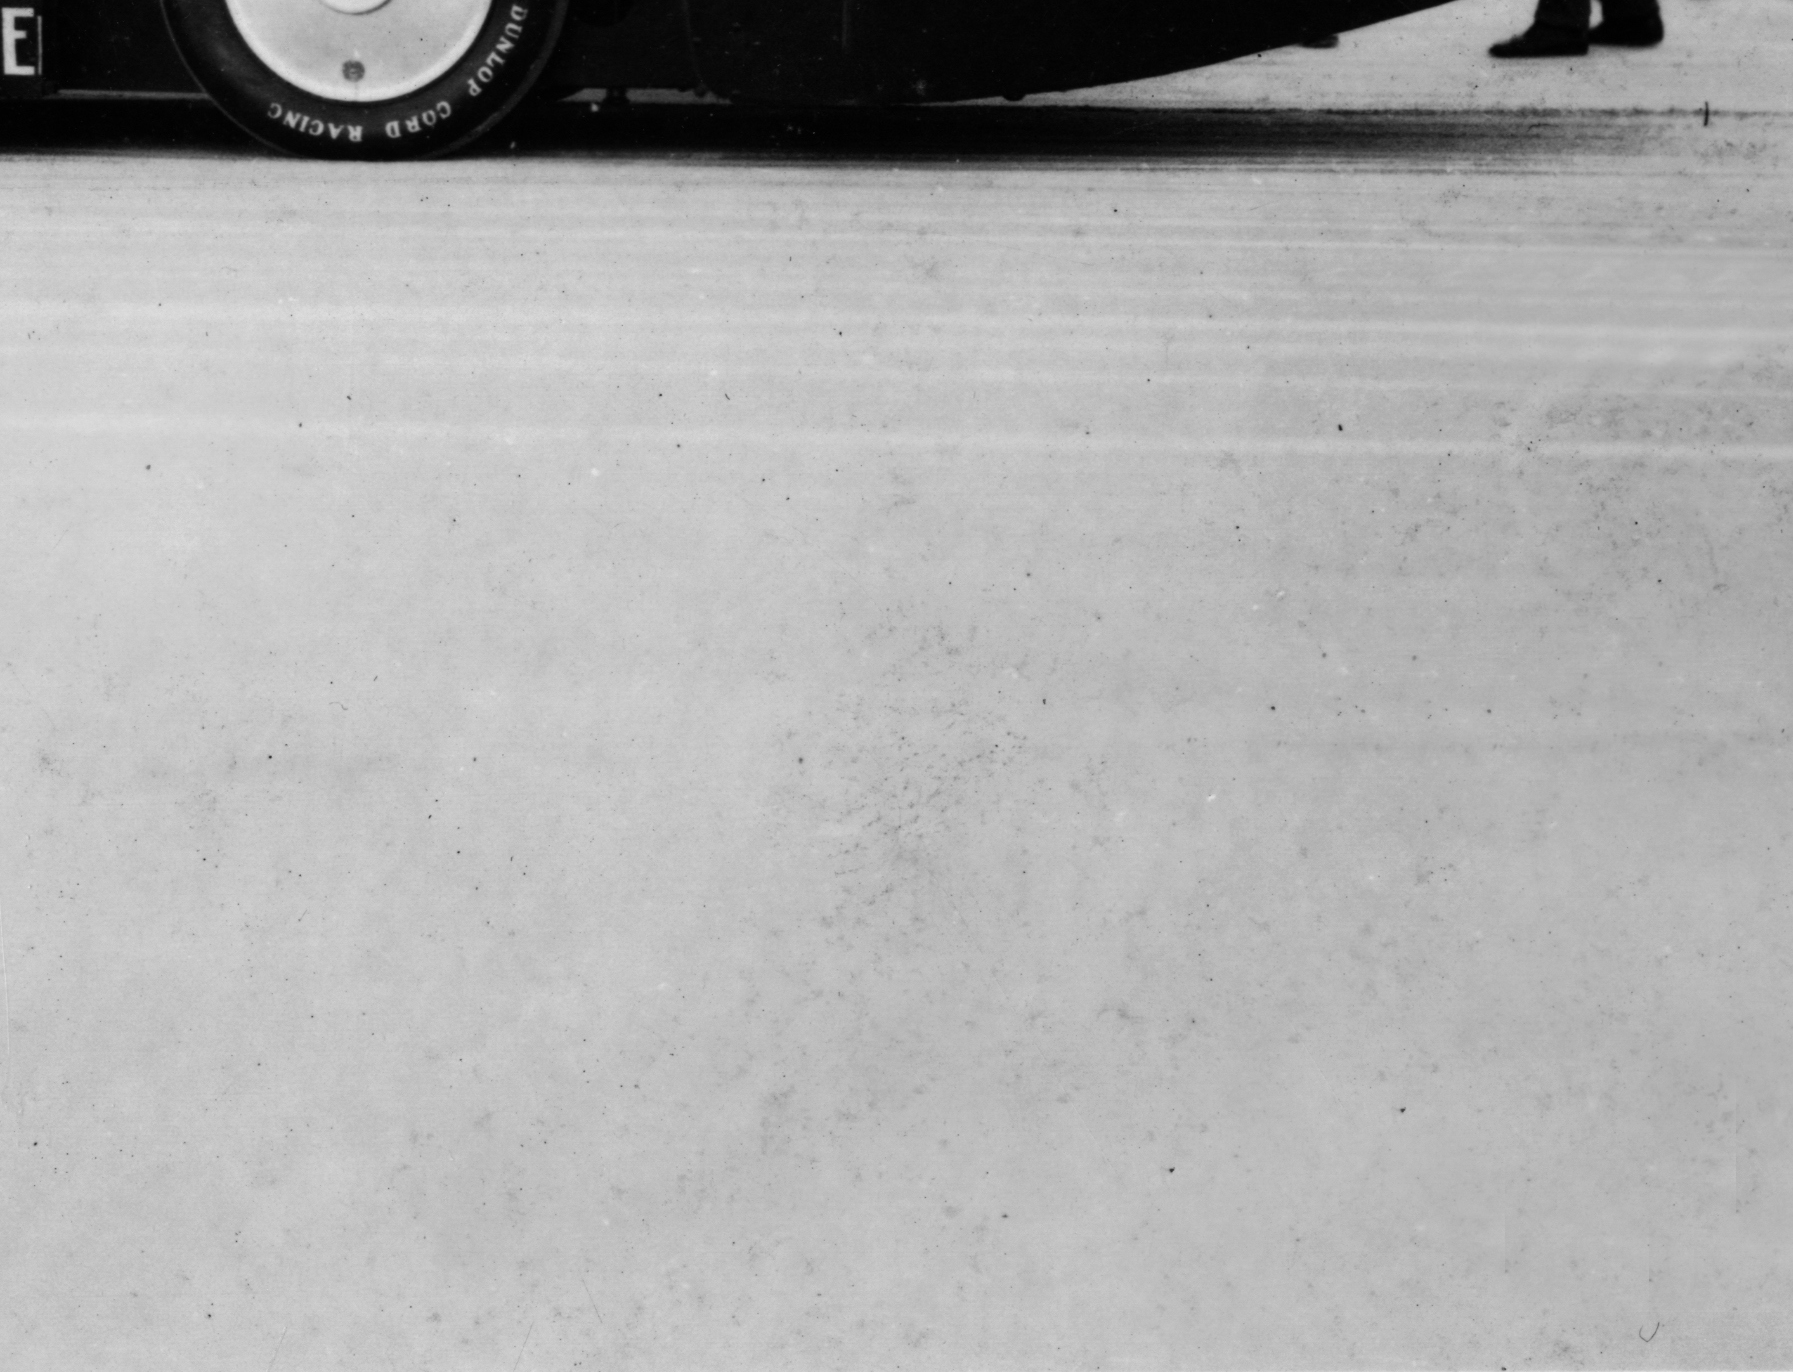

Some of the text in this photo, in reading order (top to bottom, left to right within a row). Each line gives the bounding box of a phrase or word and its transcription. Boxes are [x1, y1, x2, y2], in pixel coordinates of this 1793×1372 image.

[1, 6, 42, 76] E
[266, 4, 528, 143] DUNLOP CORD RACING
